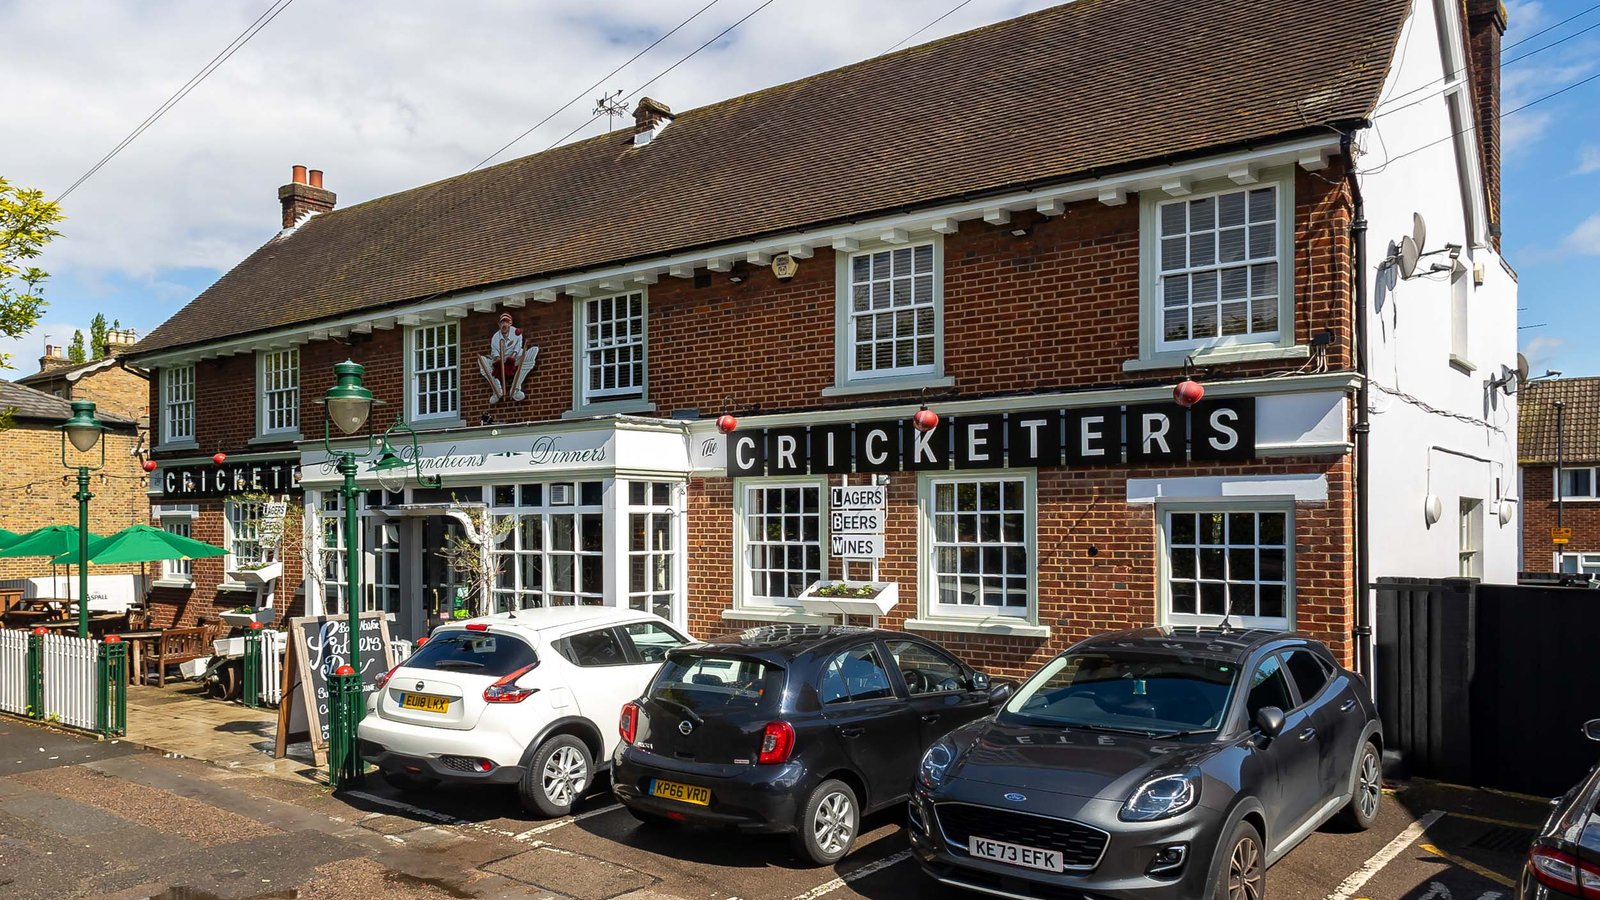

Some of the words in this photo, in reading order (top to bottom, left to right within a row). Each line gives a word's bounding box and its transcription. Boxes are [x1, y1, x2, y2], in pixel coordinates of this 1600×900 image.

[529, 436, 606, 465] Dinners
[701, 438, 718, 457] The
[736, 408, 1239, 470] CRICKETERS
[166, 465, 300, 493] CRICKETE
[833, 489, 882, 505] LAGERS
[833, 514, 877, 530] BEERS
[833, 537, 873, 555] WINES
[307, 620, 382, 670] Faters
[406, 695, 426, 708] EU18
[427, 697, 446, 711] LKX
[656, 781, 685, 798] KP66
[687, 787, 708, 802] VRD
[976, 840, 1017, 861] KE73
[1022, 848, 1055, 868] EFK
